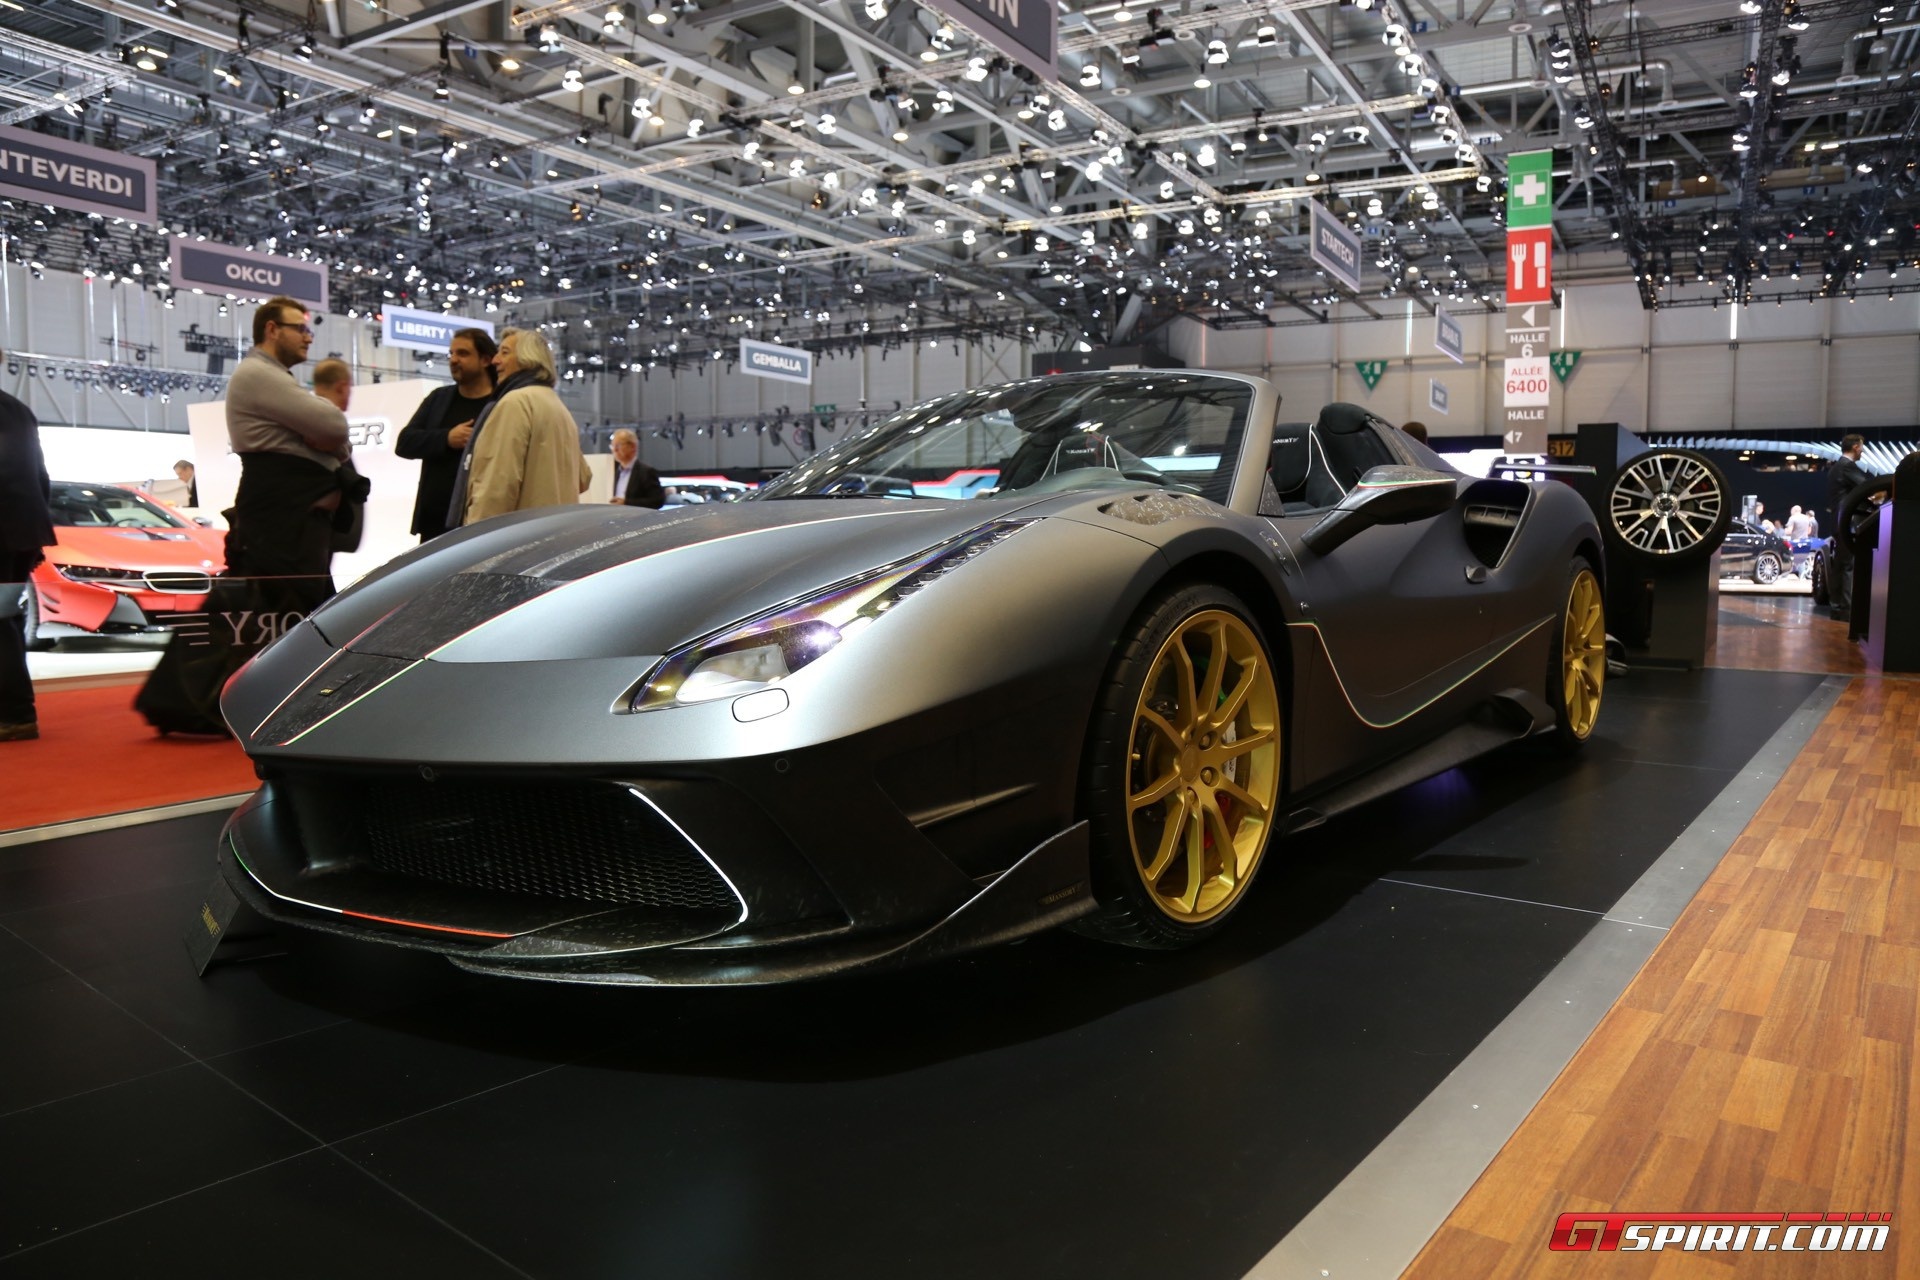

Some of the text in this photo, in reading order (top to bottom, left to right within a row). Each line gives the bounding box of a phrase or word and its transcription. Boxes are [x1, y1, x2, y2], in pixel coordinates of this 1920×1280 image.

[1321, 228, 1354, 268] STARTECH
[226, 263, 281, 287] OKCU
[395, 321, 447, 339] LIBERTY
[1510, 333, 1545, 343] HALLE
[1522, 343, 1533, 358] 6
[752, 352, 802, 372] GEMBALLA
[1512, 365, 1543, 376] ALLÉE
[1507, 379, 1547, 393] 6400
[1508, 410, 1544, 420] HALLE
[1515, 432, 1522, 442] 7
